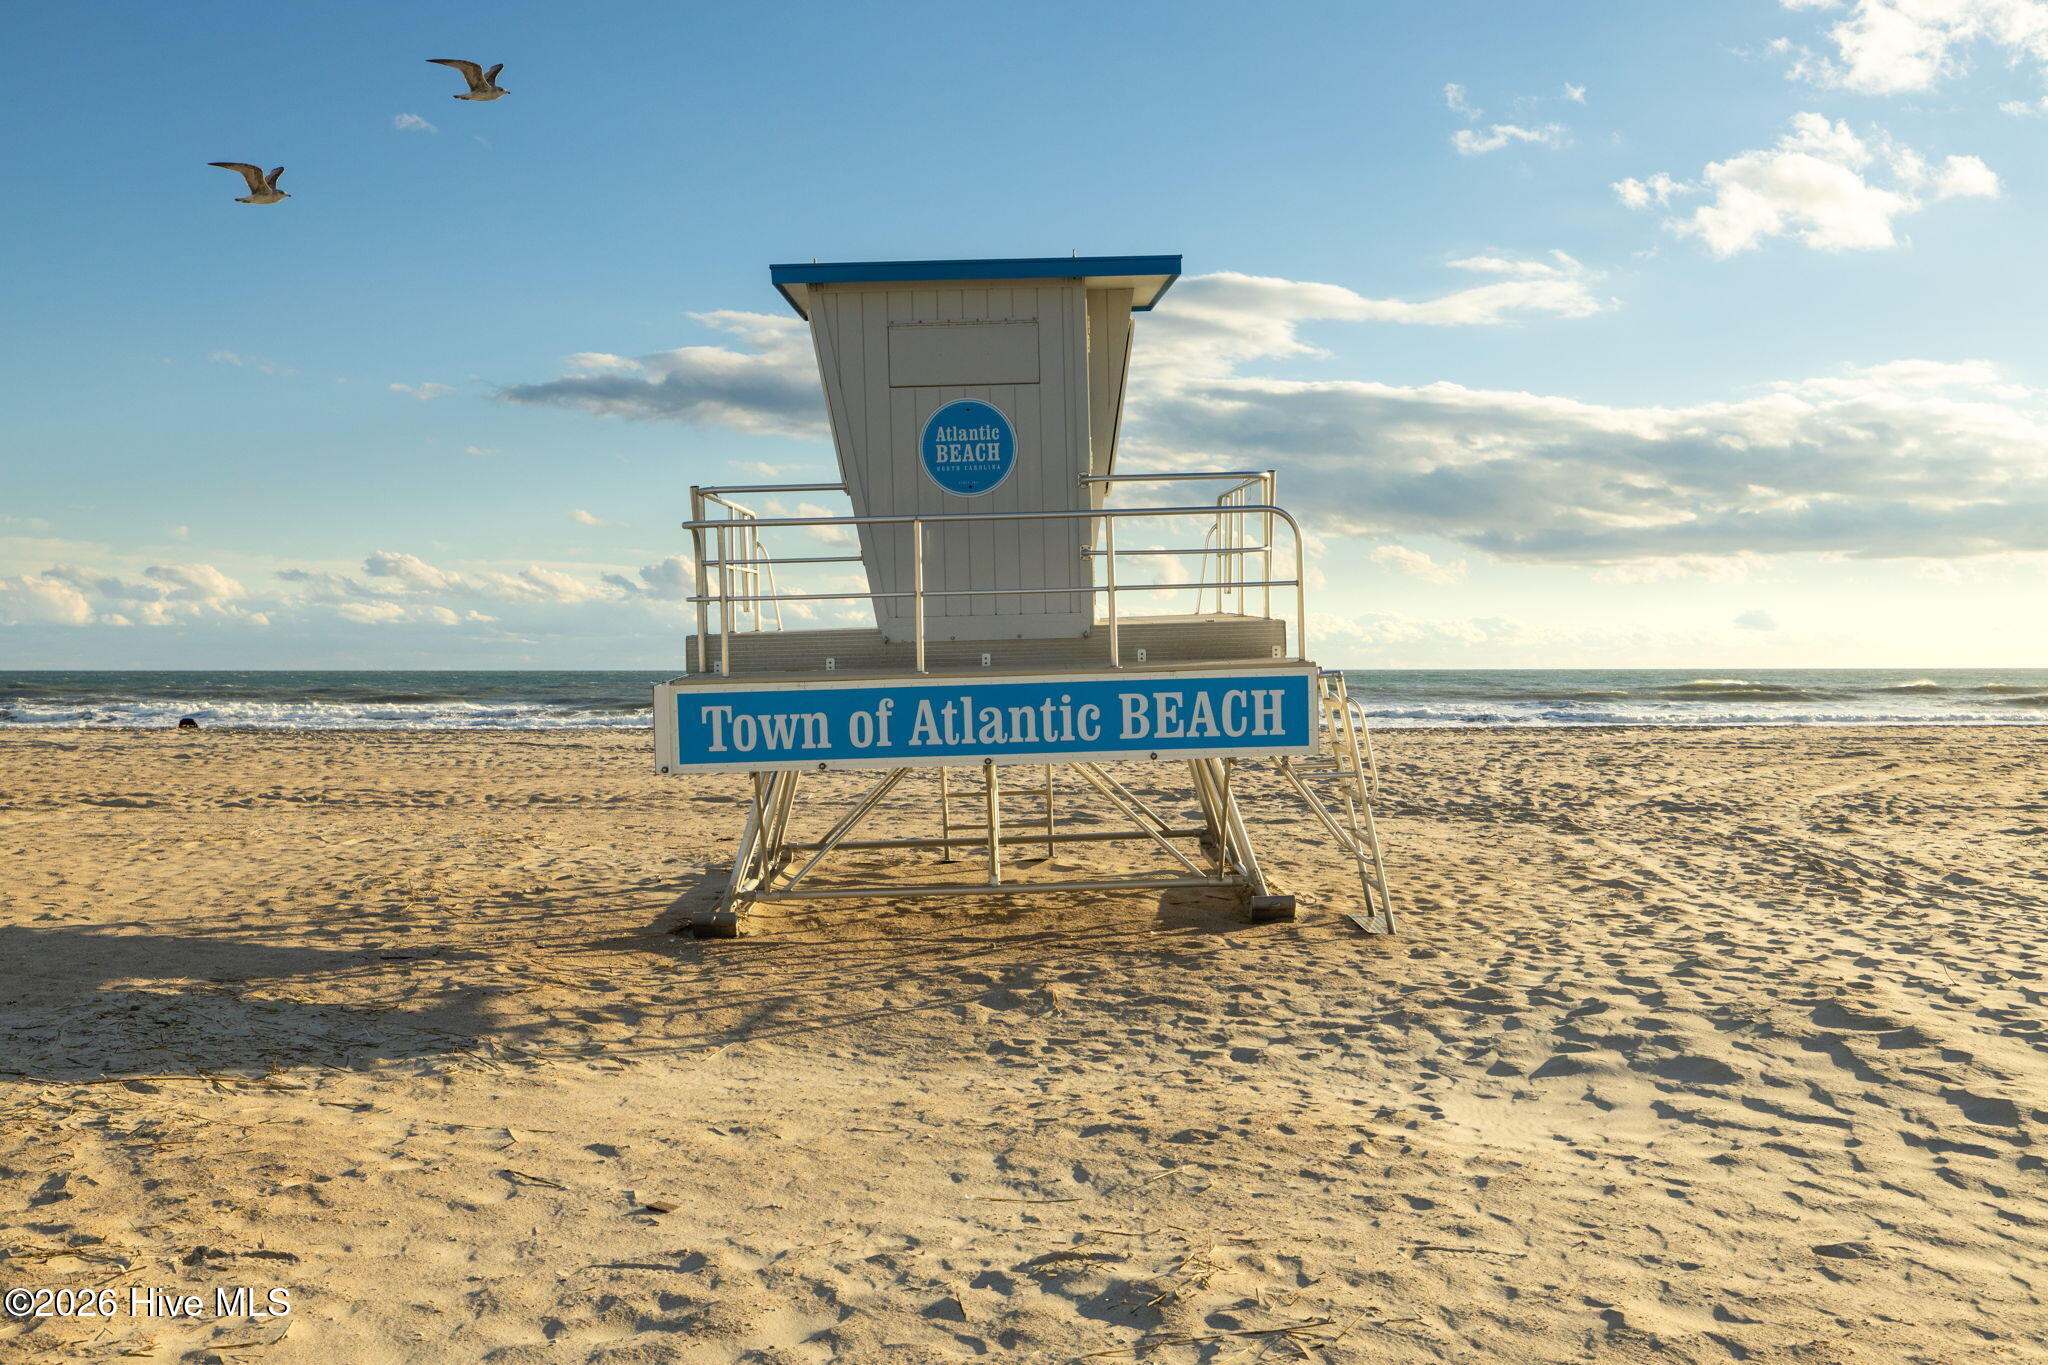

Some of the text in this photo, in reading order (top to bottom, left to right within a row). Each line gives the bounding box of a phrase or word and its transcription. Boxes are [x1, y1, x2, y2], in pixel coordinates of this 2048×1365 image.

[936, 424, 1000, 442] Atlantic
[936, 443, 1001, 463] BEACH
[701, 689, 1286, 752] Town of Atlantic BEACH
